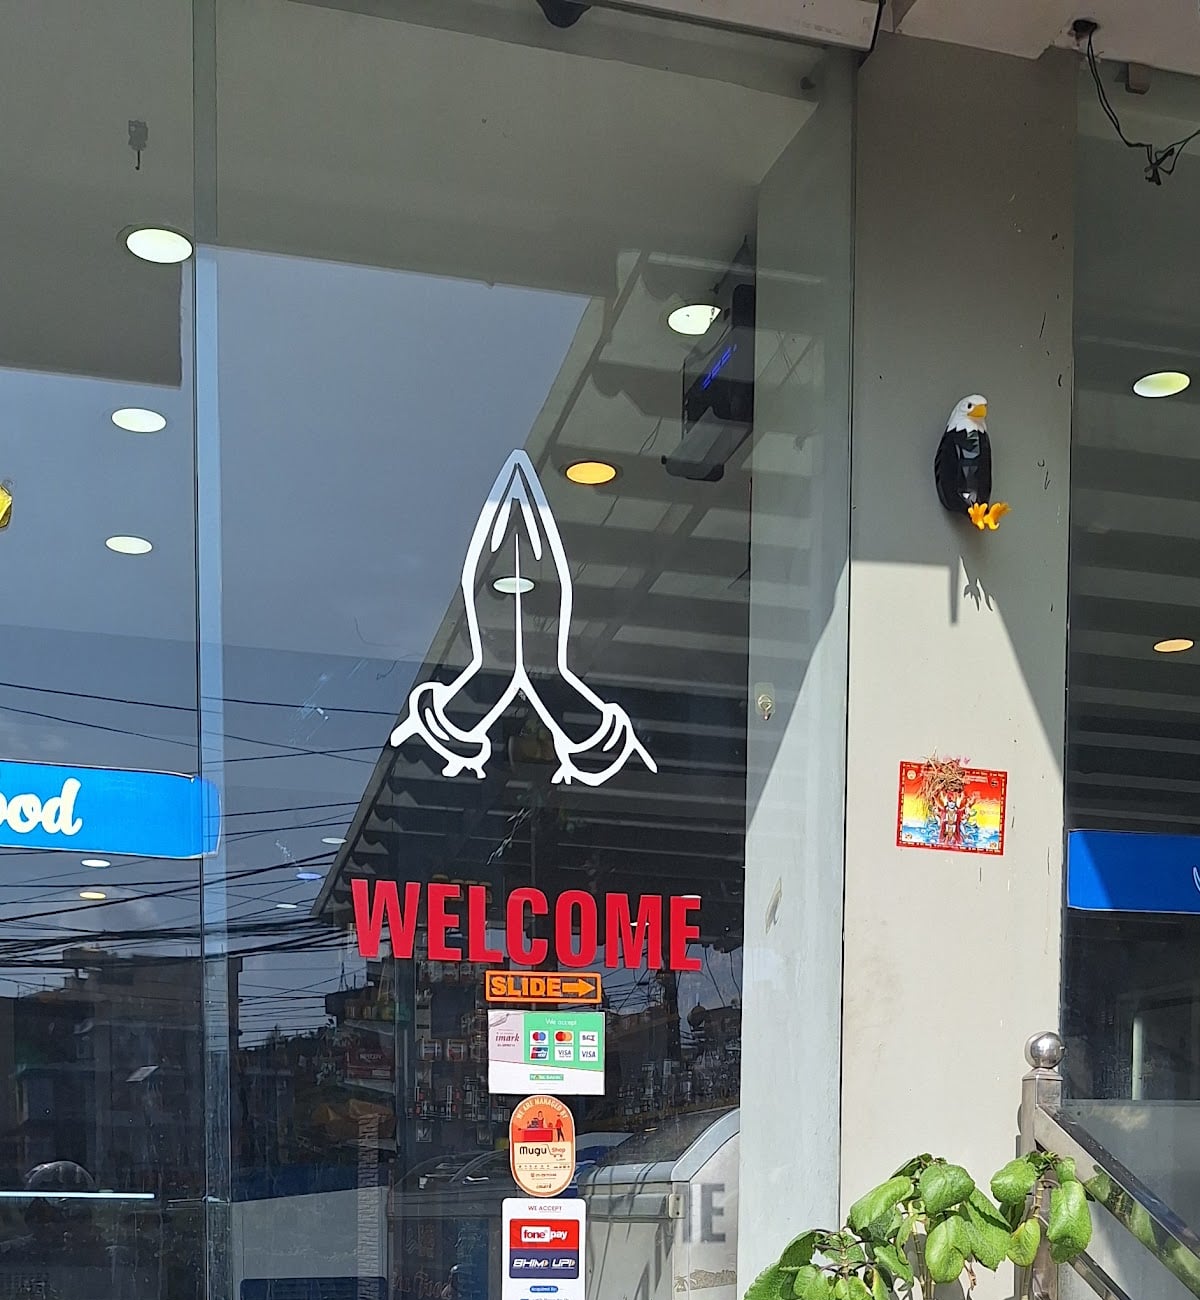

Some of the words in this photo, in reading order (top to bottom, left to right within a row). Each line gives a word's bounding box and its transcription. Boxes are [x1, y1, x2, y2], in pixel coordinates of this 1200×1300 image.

[0, 777, 83, 836] od
[351, 878, 702, 971] WELCOME
[490, 976, 563, 997] SLIDE
[544, 1017, 556, 1026] We
[581, 1050, 596, 1058] VISA
[534, 1097, 561, 1112] MANAGED
[519, 1146, 547, 1157] Mugu
